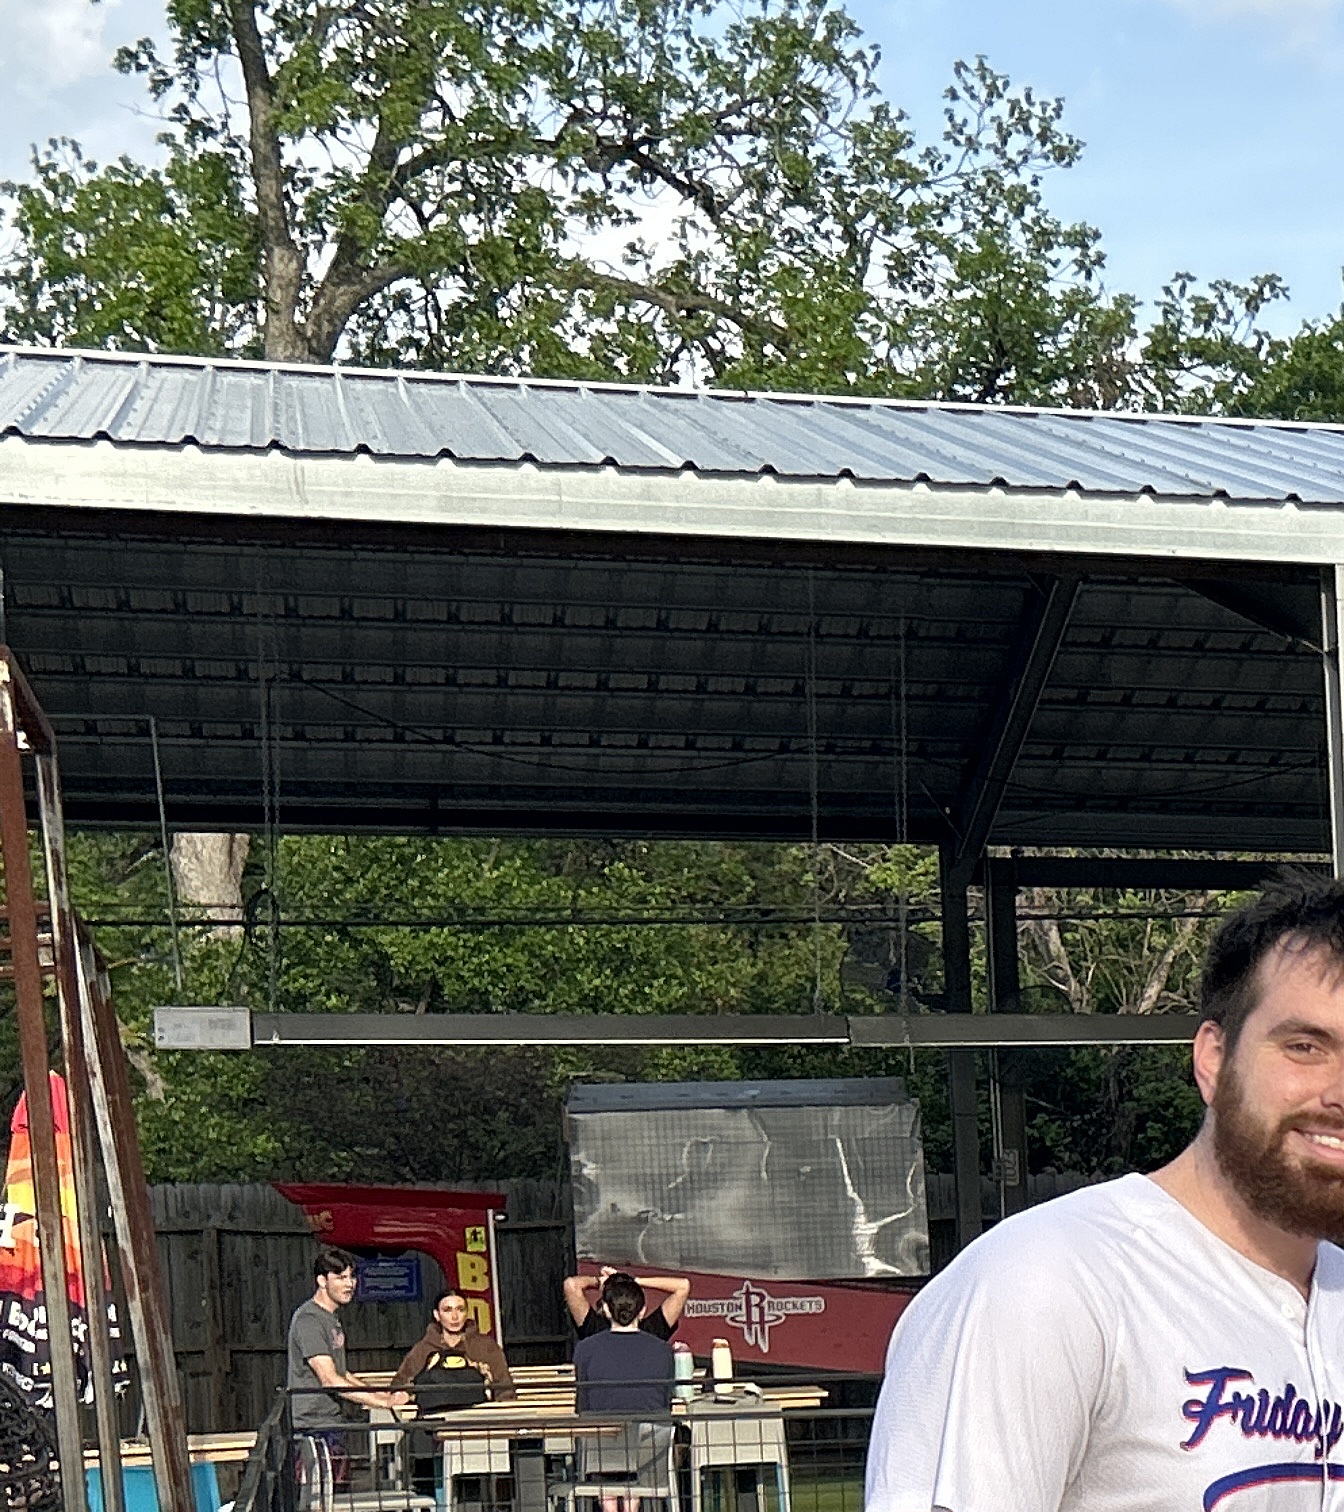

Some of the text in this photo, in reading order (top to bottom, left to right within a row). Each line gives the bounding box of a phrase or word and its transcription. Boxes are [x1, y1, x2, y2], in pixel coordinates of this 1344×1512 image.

[686, 1302, 743, 1316] HOUSTON
[767, 1299, 824, 1314] ROCKETS
[1180, 1366, 1344, 1461] Friday
